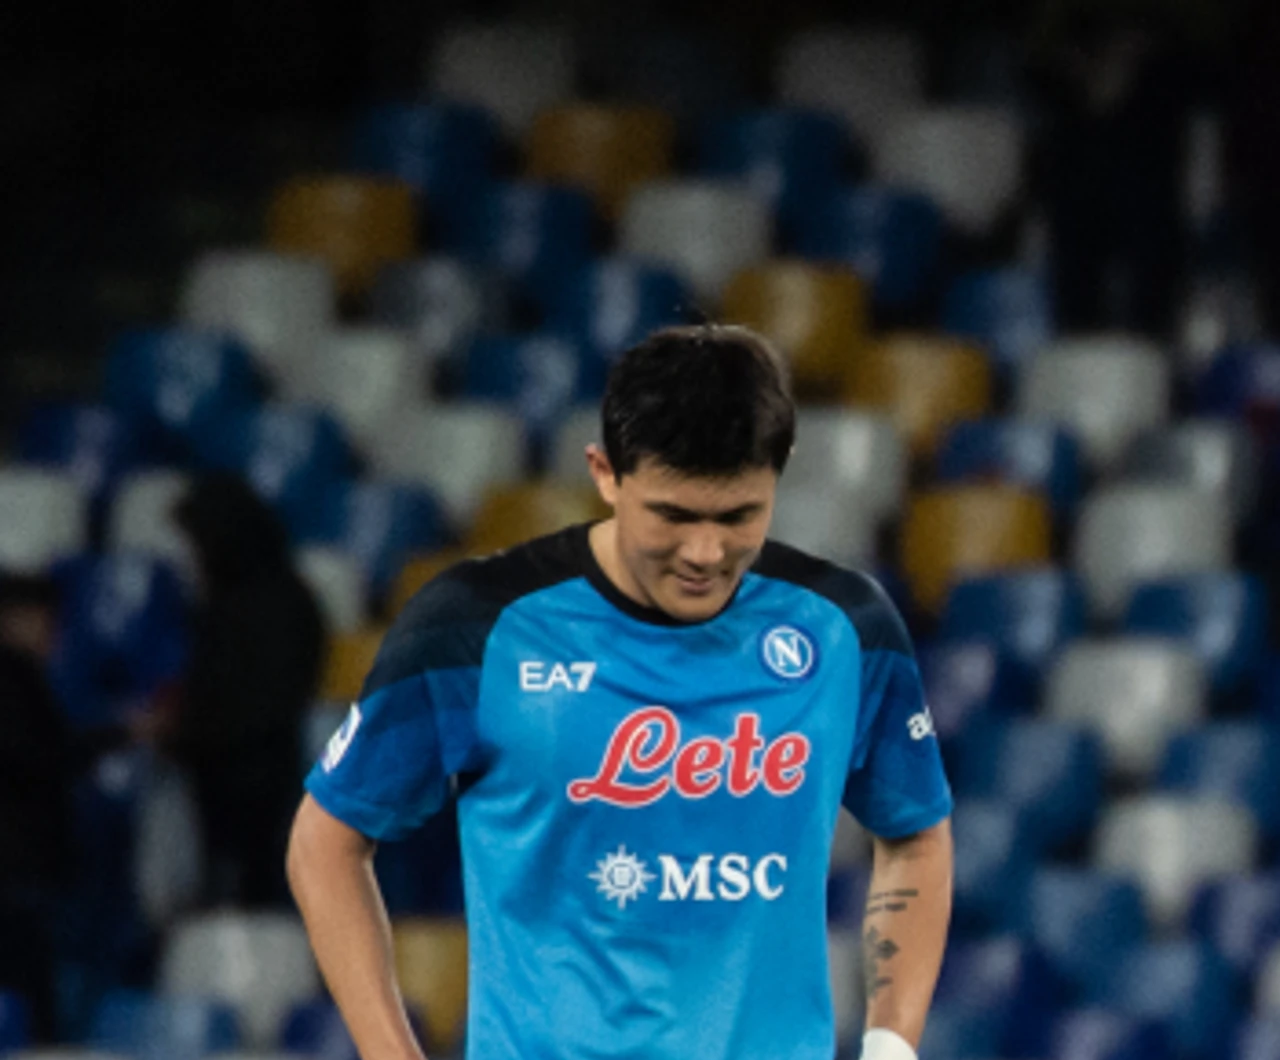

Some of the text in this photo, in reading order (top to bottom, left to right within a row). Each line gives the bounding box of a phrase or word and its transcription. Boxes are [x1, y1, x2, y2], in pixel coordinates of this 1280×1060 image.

[518, 660, 597, 693] EA7
[568, 706, 810, 808] Lete
[658, 854, 787, 901] MSC
